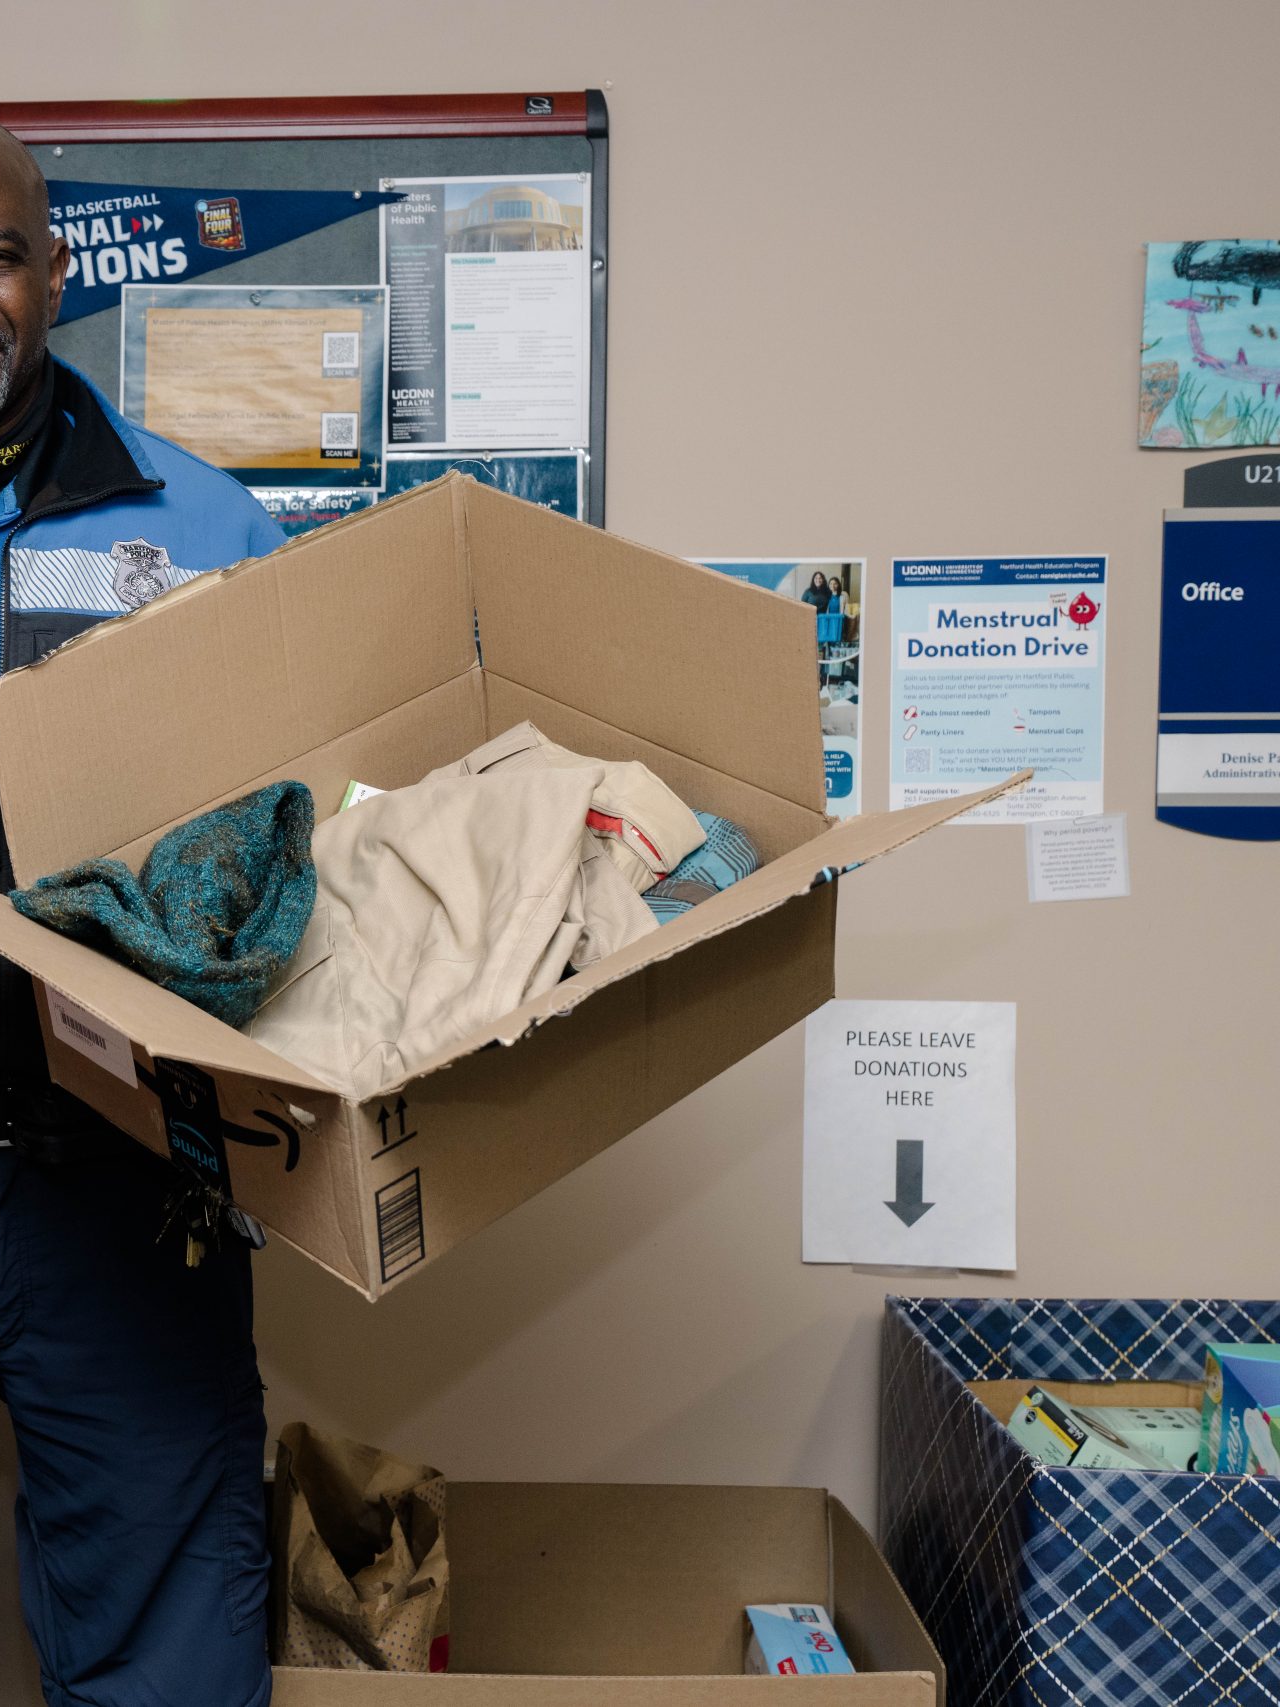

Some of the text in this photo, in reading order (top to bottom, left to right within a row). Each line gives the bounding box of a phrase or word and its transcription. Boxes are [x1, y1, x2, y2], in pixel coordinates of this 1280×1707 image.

[65, 193, 161, 218] BASKETBALL
[391, 203, 437, 214] of Public
[203, 207, 232, 222] FINAL
[391, 215, 425, 225] Health
[205, 218, 233, 233] FOUR
[392, 388, 434, 400] UCONN
[285, 500, 305, 511] for
[902, 565, 941, 576] UCONN
[1182, 582, 1244, 601] Office
[936, 608, 1058, 628] Menstrual
[908, 636, 1088, 658] Donation Drive
[1060, 682, 1090, 690] donating
[968, 692, 999, 700] packages
[940, 710, 959, 718] (most
[961, 709, 990, 718] needed)
[1028, 708, 1060, 716] Tampons
[920, 729, 940, 737] Panty
[1028, 727, 1064, 735] Menstrual
[1066, 727, 1084, 736] Cups
[1221, 752, 1264, 764] Denise
[1203, 769, 1280, 778] Administrativ
[845, 1029, 977, 1050] PLEASE LEAVE
[853, 1060, 968, 1080] DONATIONS
[885, 1090, 934, 1108] HERE
[172, 1133, 219, 1174] prime
